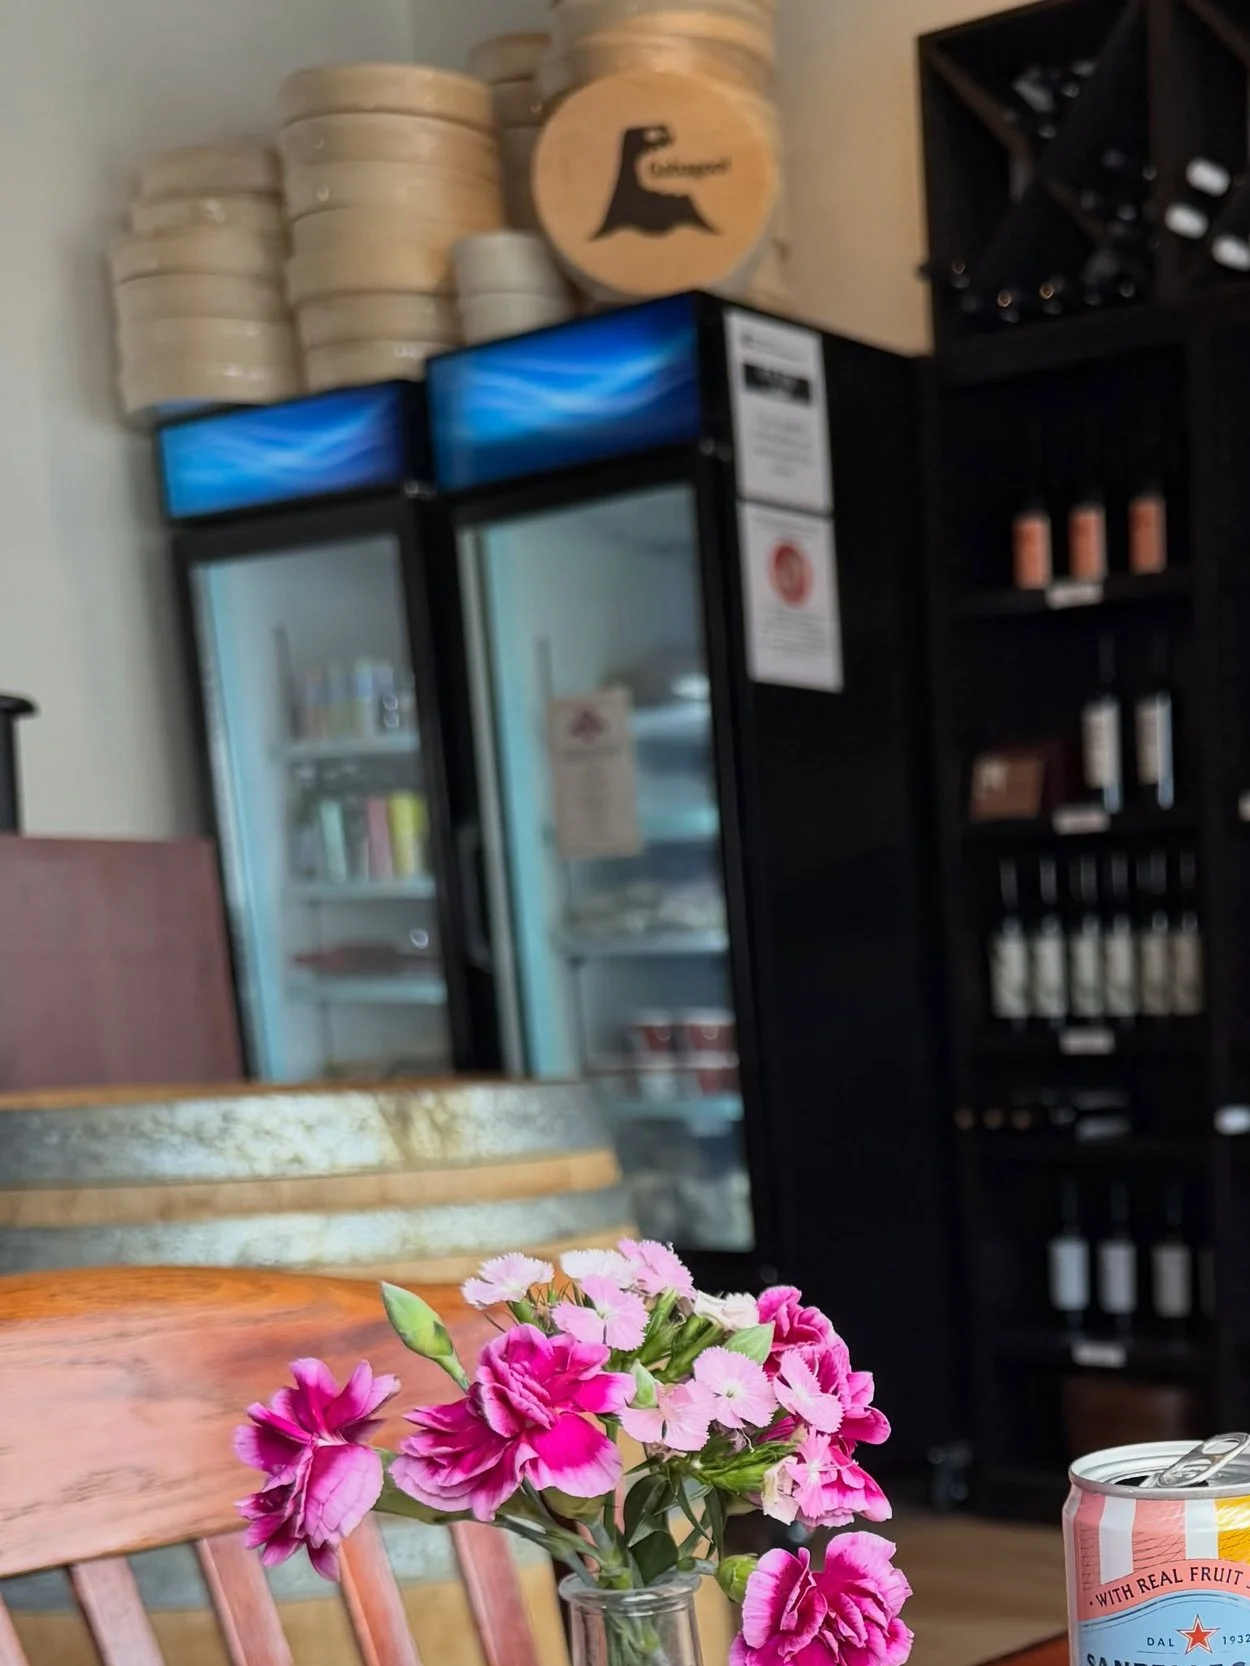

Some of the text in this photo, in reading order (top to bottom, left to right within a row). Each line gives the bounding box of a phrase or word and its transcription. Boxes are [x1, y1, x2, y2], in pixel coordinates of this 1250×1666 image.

[1095, 1583, 1135, 1608] WITH
[1139, 1568, 1183, 1593] REAL
[1190, 1566, 1243, 1586] FRUIT
[1147, 1637, 1175, 1647] DAL
